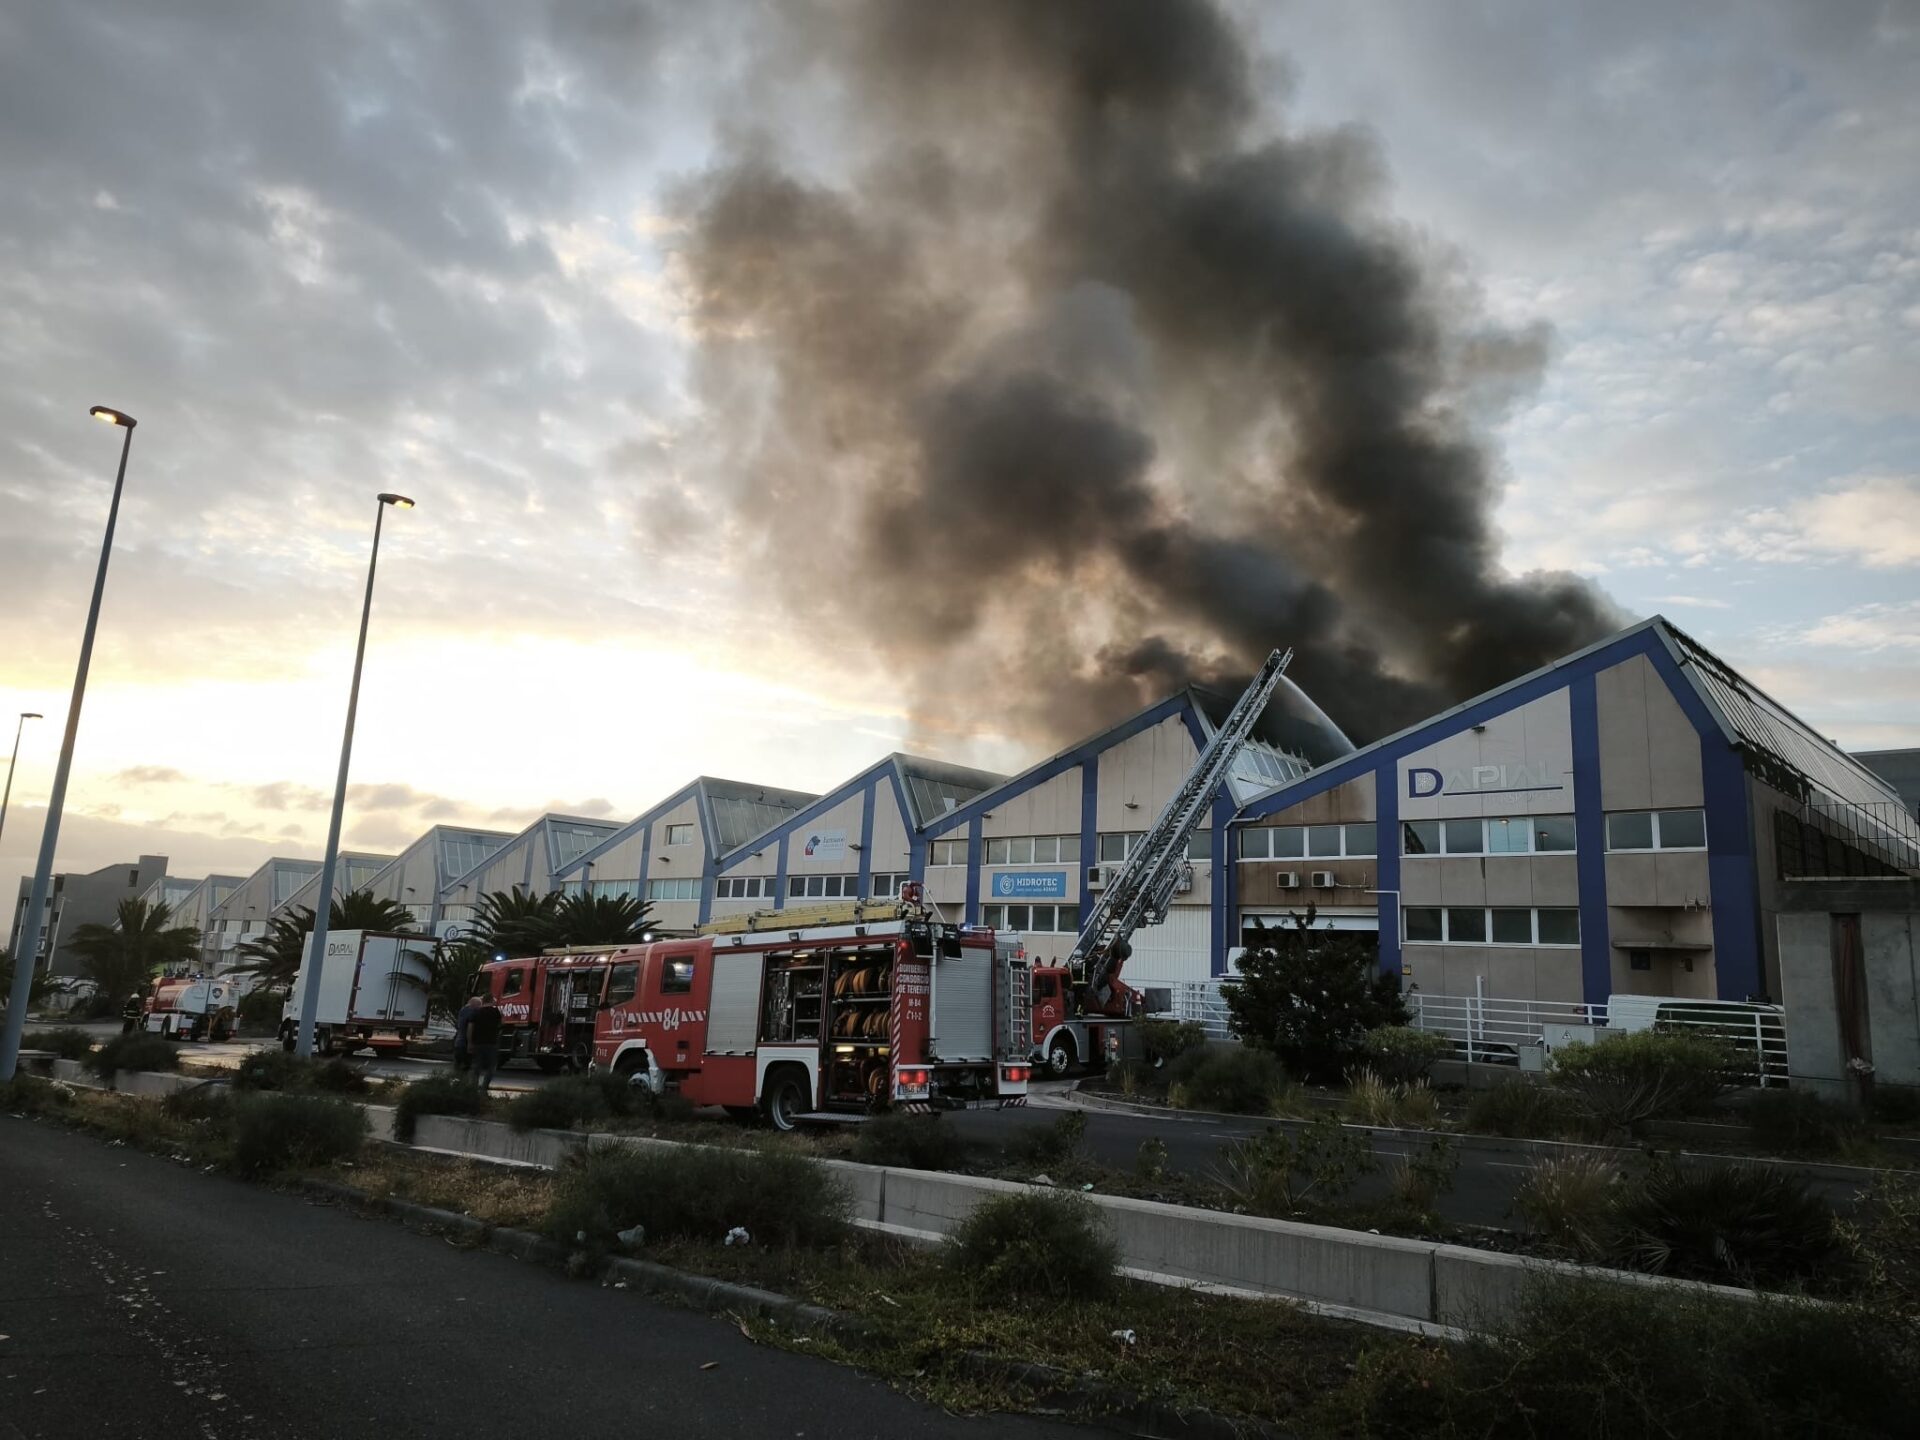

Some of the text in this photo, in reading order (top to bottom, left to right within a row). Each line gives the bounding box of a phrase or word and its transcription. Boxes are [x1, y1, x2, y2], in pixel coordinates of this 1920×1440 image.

[1408, 761, 1561, 798] DAPIAL
[1016, 878, 1058, 886] HIDROTEC
[899, 984, 906, 994] DE
[663, 1008, 680, 1031] 84
